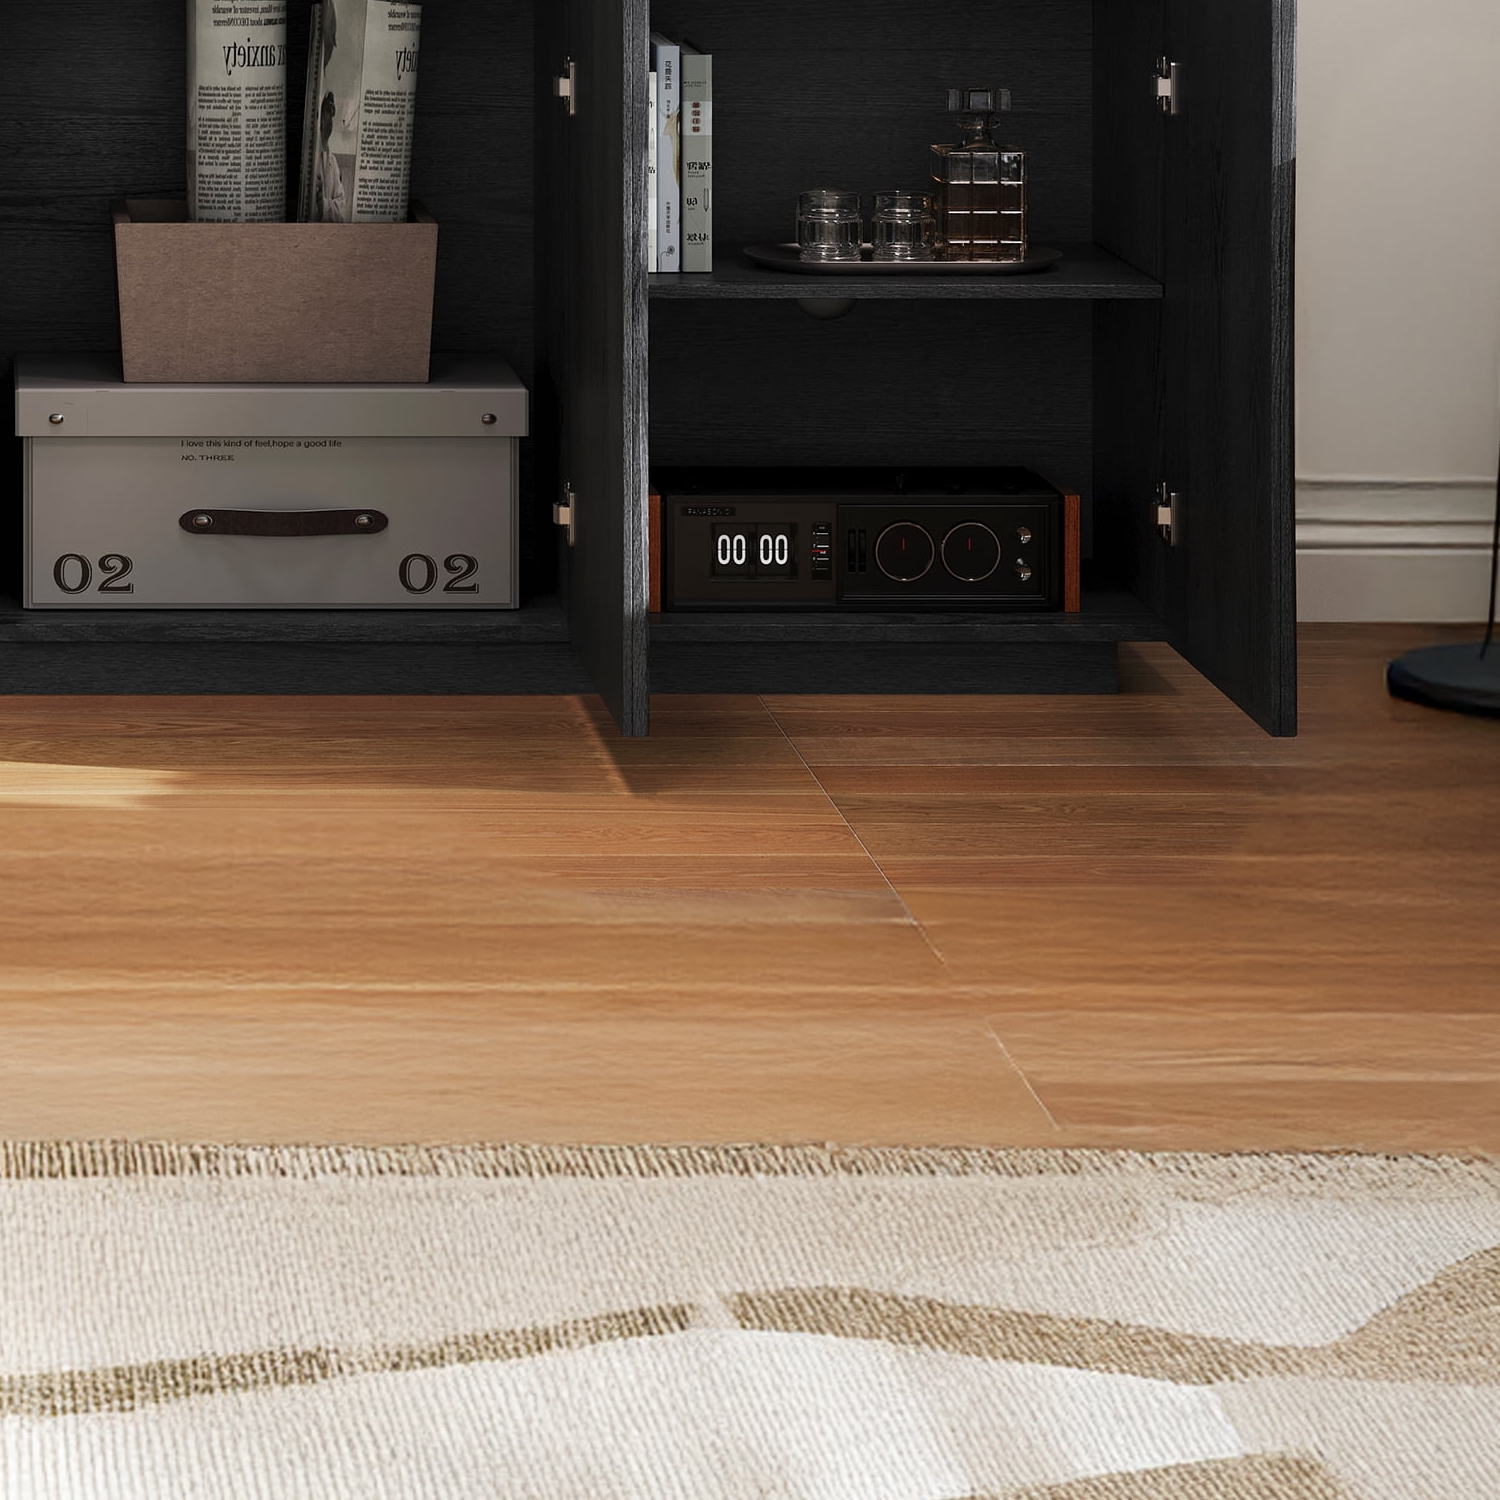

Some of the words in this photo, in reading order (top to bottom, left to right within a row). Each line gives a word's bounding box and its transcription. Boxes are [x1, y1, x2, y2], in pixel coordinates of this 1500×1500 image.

[303, 440, 327, 449] good
[717, 534, 747, 566] 00
[759, 534, 789, 566] 00
[52, 553, 134, 595] 02
[398, 553, 479, 595] 02
